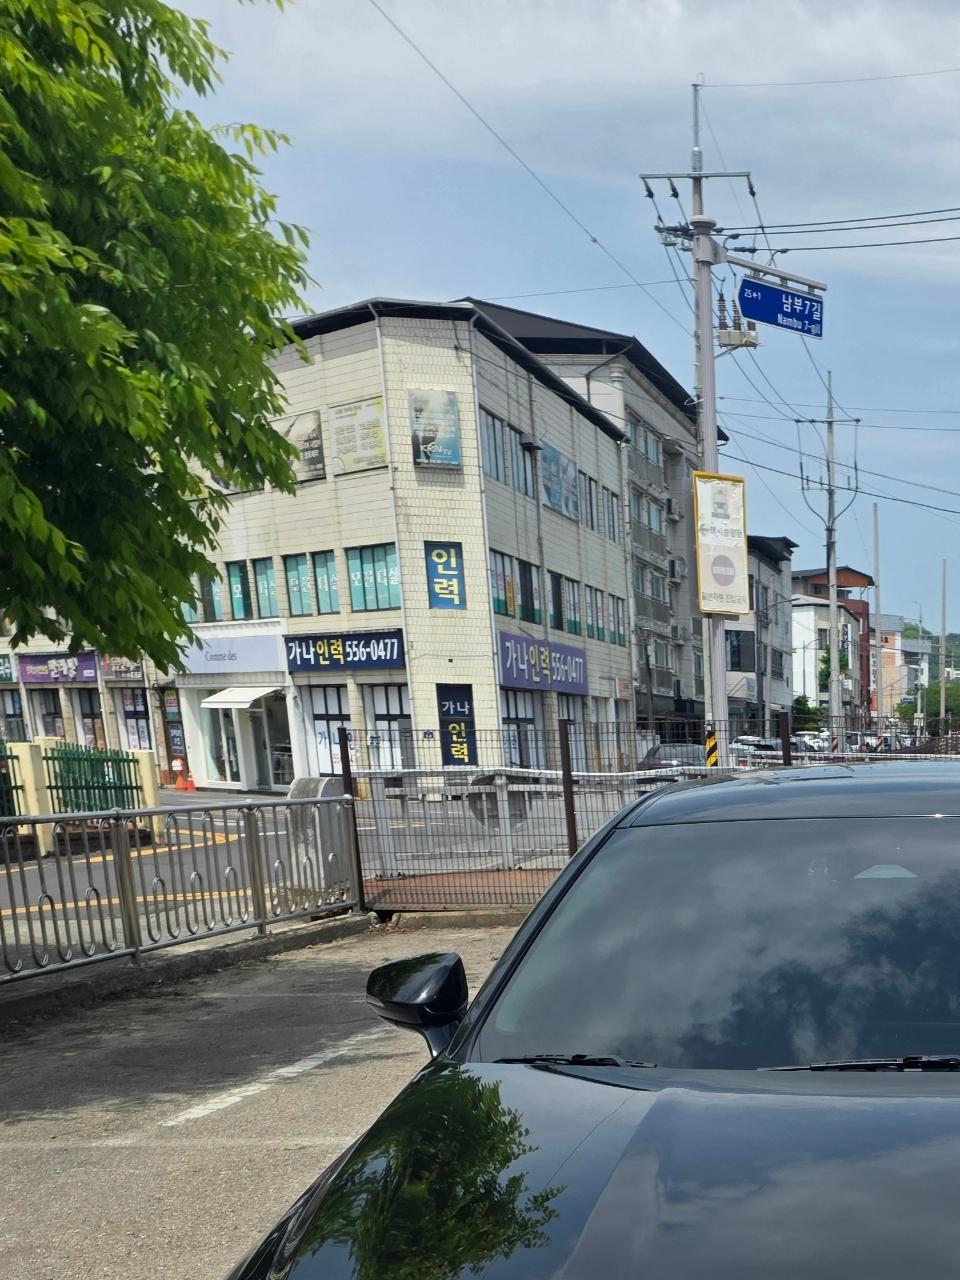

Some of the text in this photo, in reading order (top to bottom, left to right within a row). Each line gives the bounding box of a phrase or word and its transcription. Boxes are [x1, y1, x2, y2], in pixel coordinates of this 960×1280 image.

[782, 294, 821, 320] 남부7길
[778, 313, 821, 334] Nambu 7-gil
[431, 548, 459, 605] 인력
[346, 639, 398, 662] 556-0477
[552, 652, 584, 684] 556-0477
[442, 700, 470, 715] 가나
[448, 722, 469, 763] 인력
